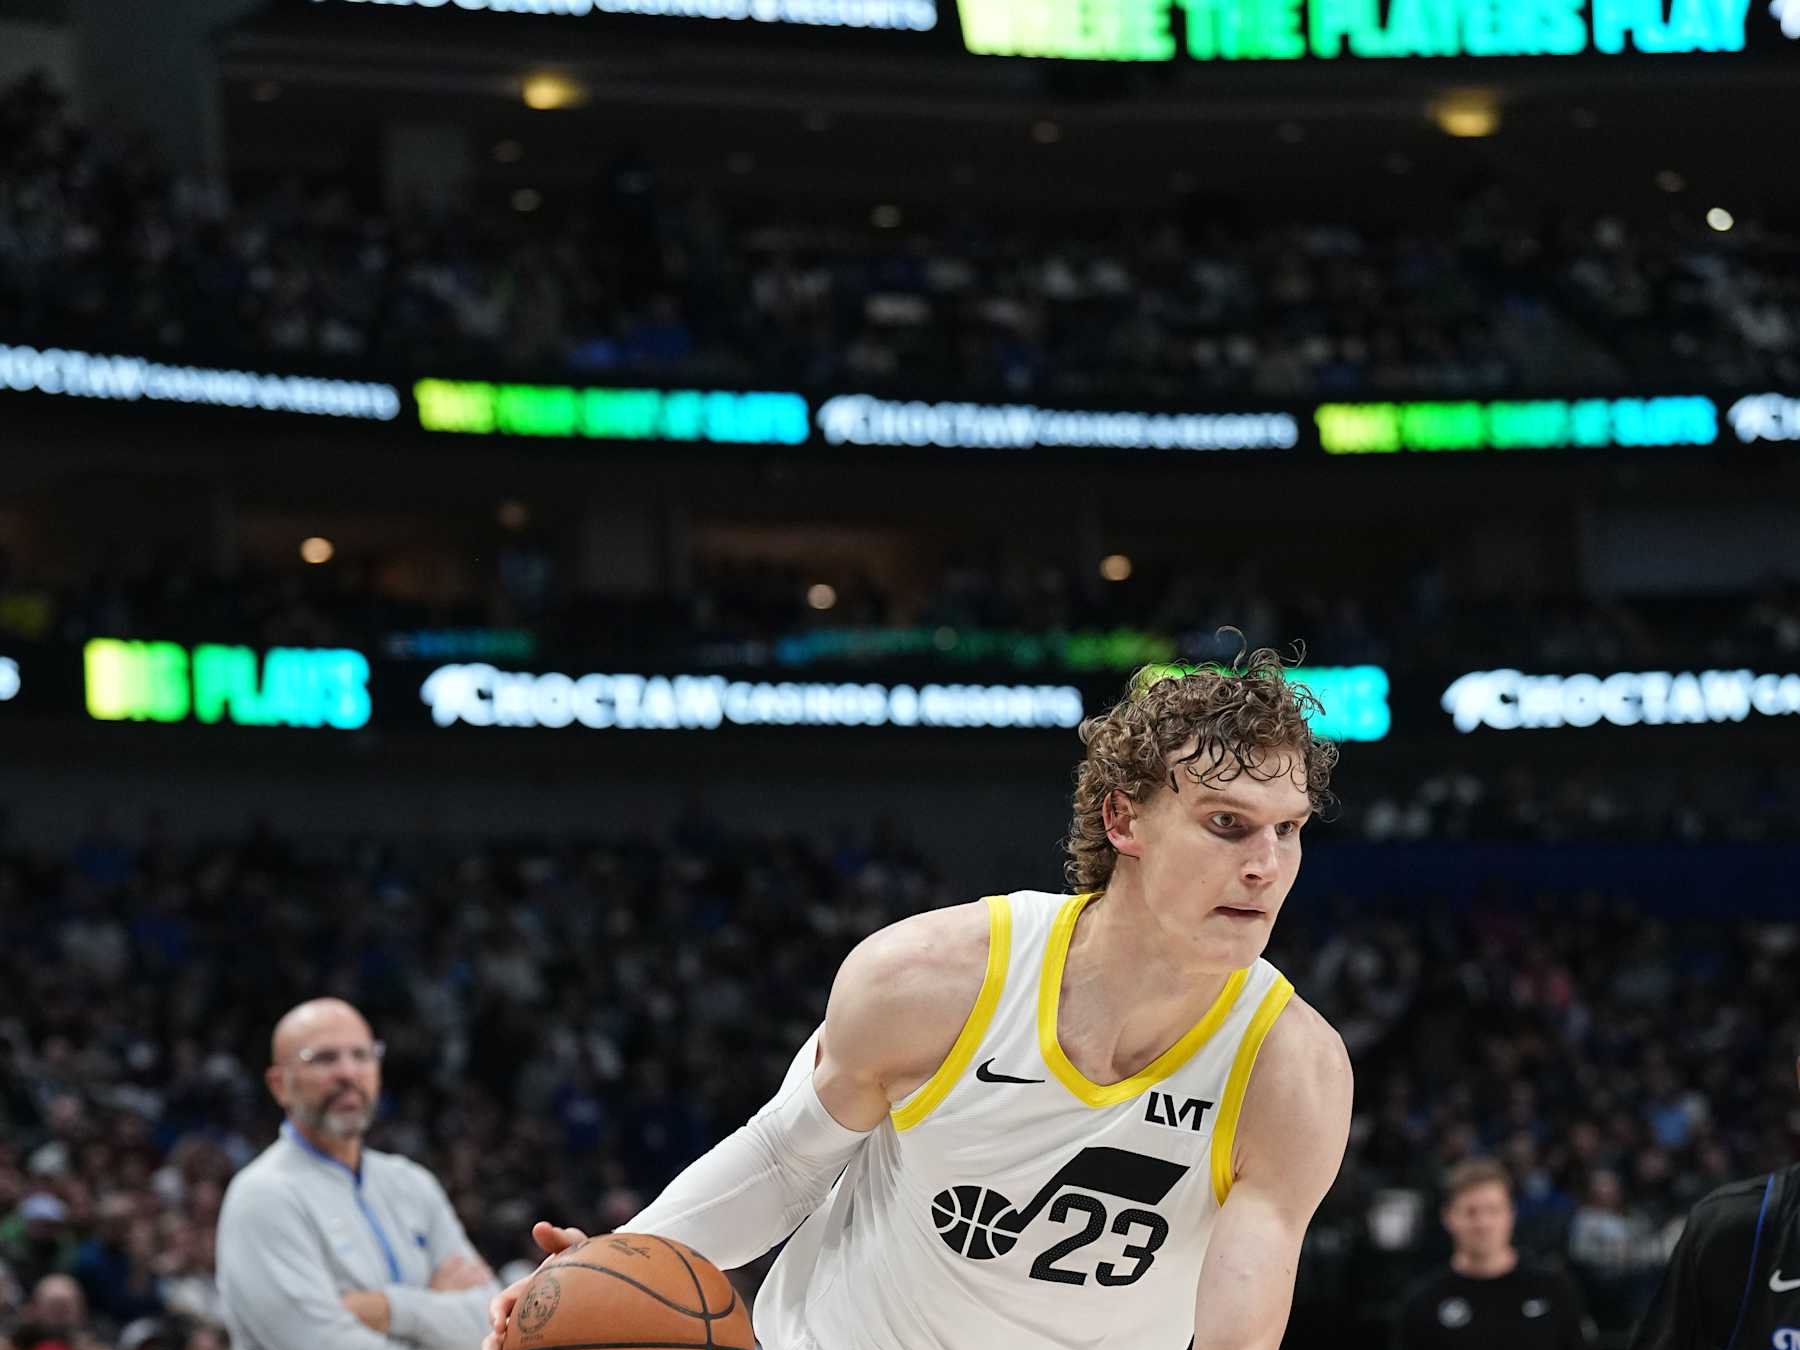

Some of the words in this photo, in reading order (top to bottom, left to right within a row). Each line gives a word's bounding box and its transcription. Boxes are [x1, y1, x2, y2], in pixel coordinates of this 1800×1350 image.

[1182, 0, 1306, 60] THE
[1307, 0, 1587, 58] PLAYERS
[1592, 0, 1750, 54] PLAY
[1029, 1193, 1170, 1287] 23
